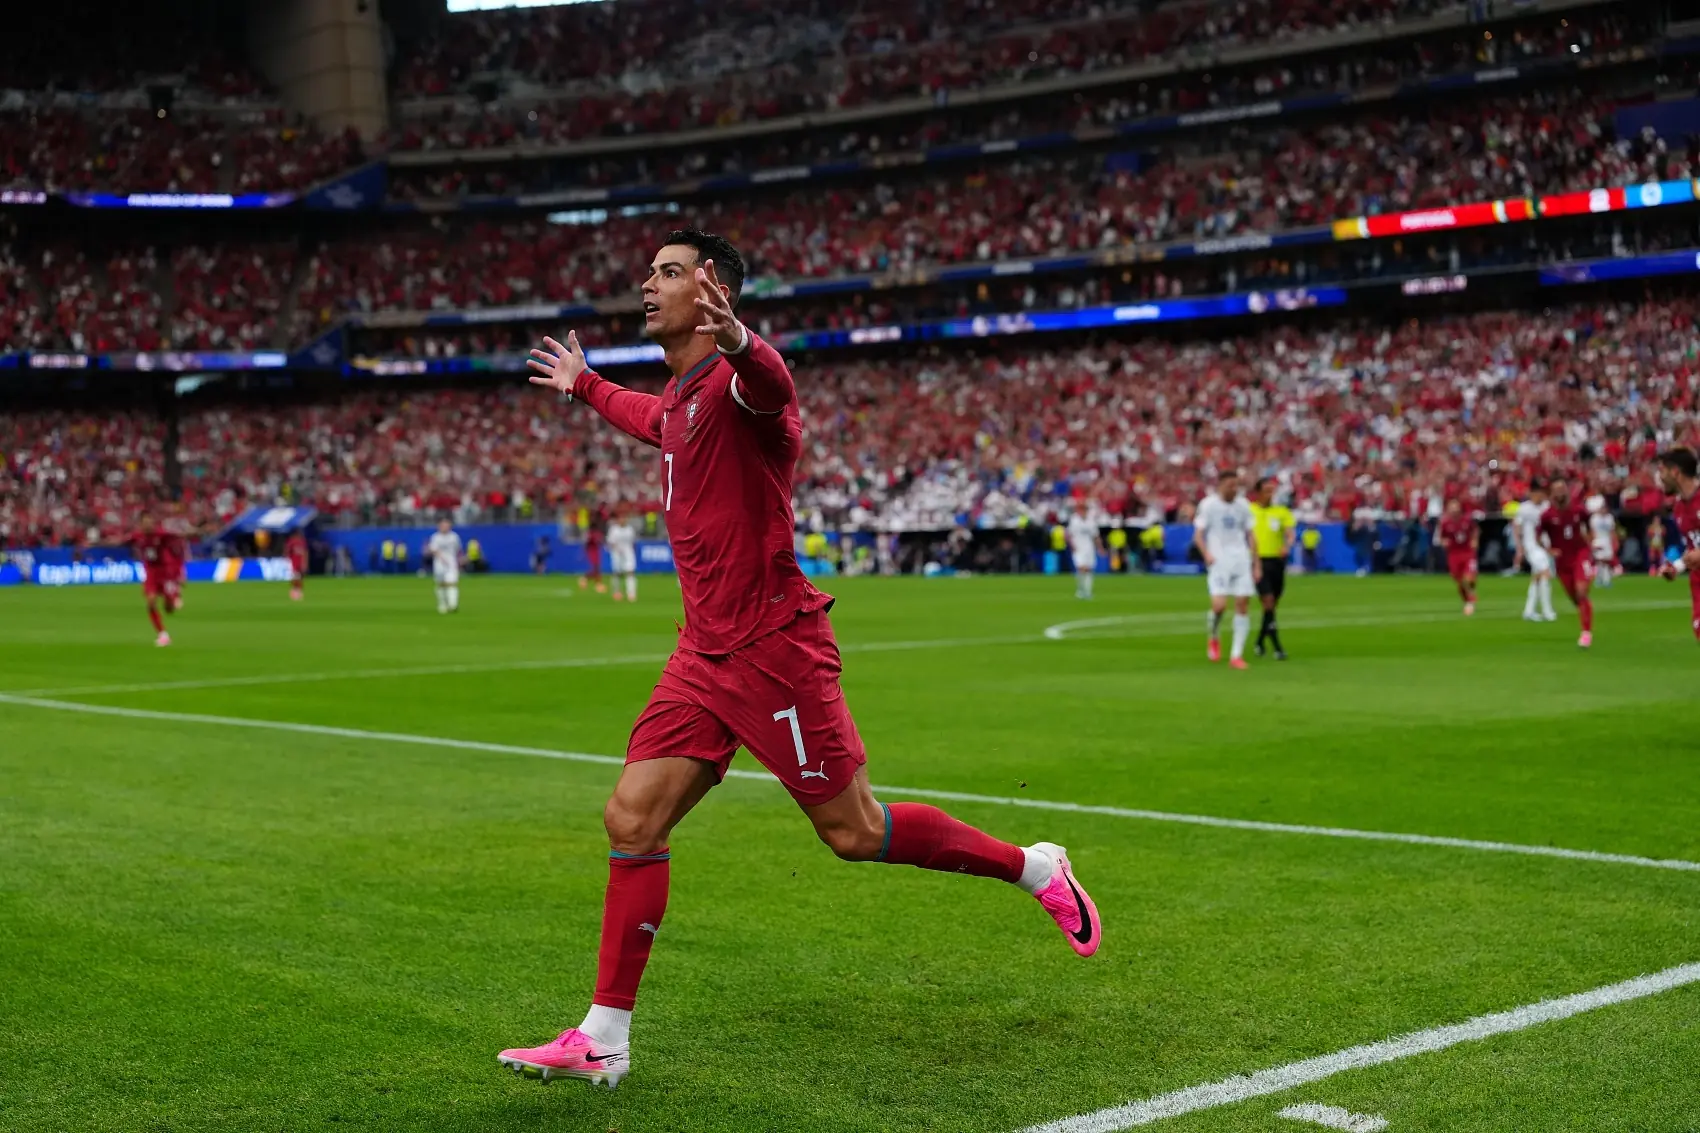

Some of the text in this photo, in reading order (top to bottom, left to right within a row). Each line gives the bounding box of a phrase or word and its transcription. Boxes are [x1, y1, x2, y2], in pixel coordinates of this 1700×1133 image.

[664, 453, 674, 511] 7
[92, 561, 134, 584] with
[772, 704, 807, 767] 7
